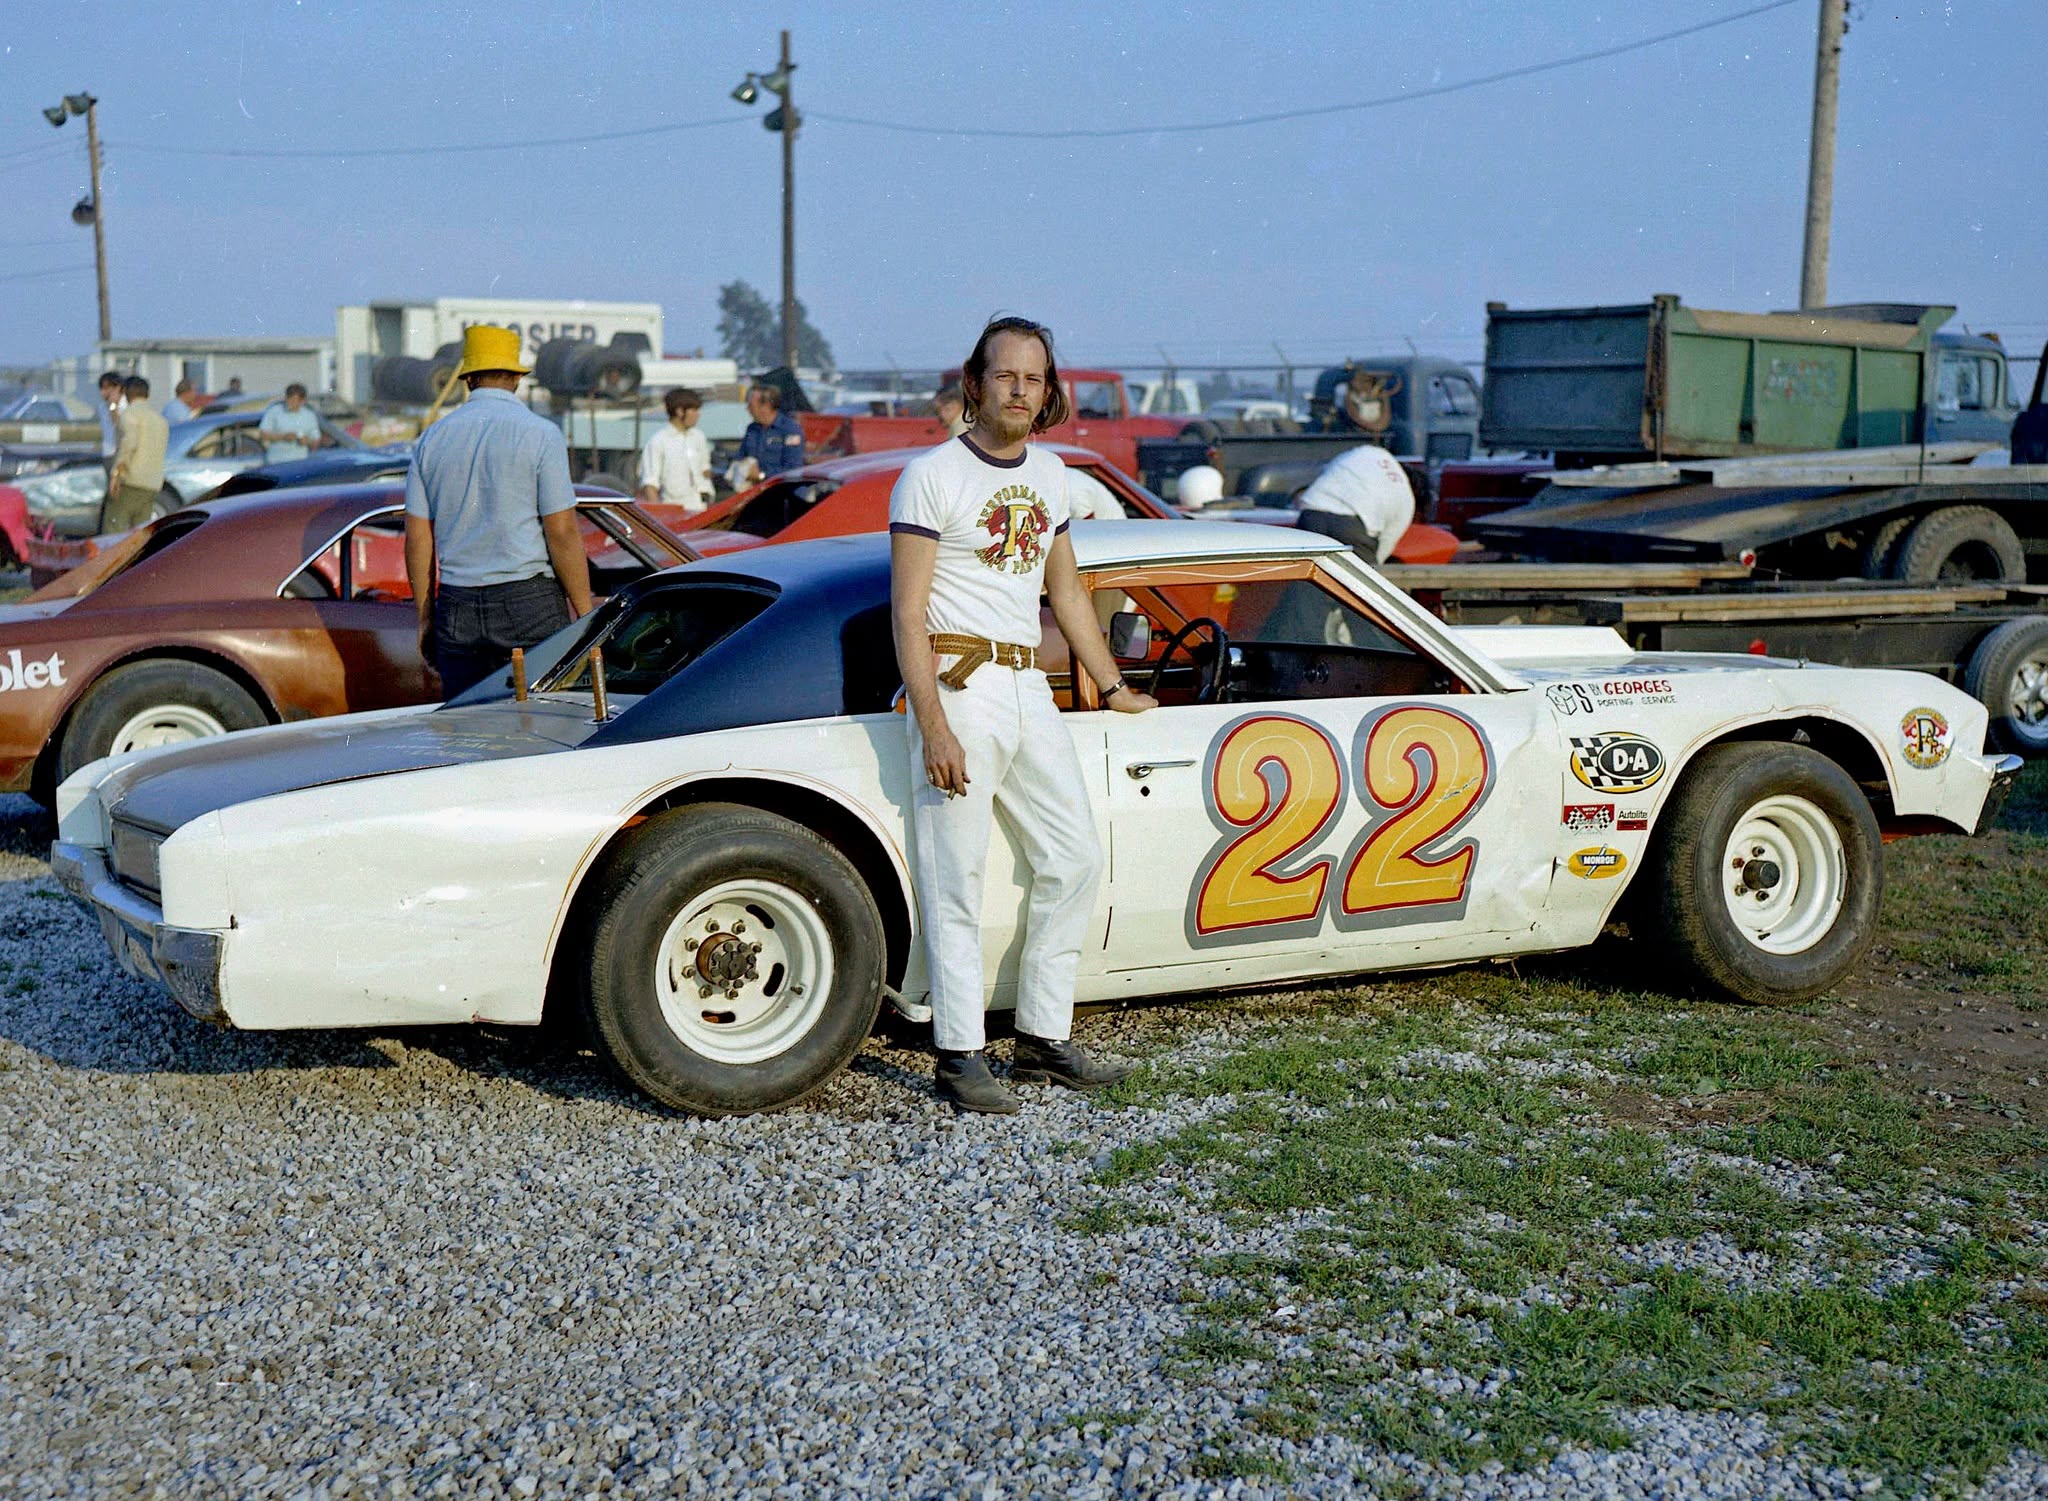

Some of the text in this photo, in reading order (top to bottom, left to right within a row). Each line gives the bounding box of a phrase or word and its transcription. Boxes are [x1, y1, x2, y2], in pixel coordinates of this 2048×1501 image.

[975, 484, 1054, 528] PERFORMANCE
[1603, 679, 1673, 696] GEORGES
[1597, 694, 1678, 708] PORTING SERVICE
[1618, 809, 1648, 819] Autolite
[1184, 701, 1498, 951] 22
[1583, 855, 1616, 865] MONROE
